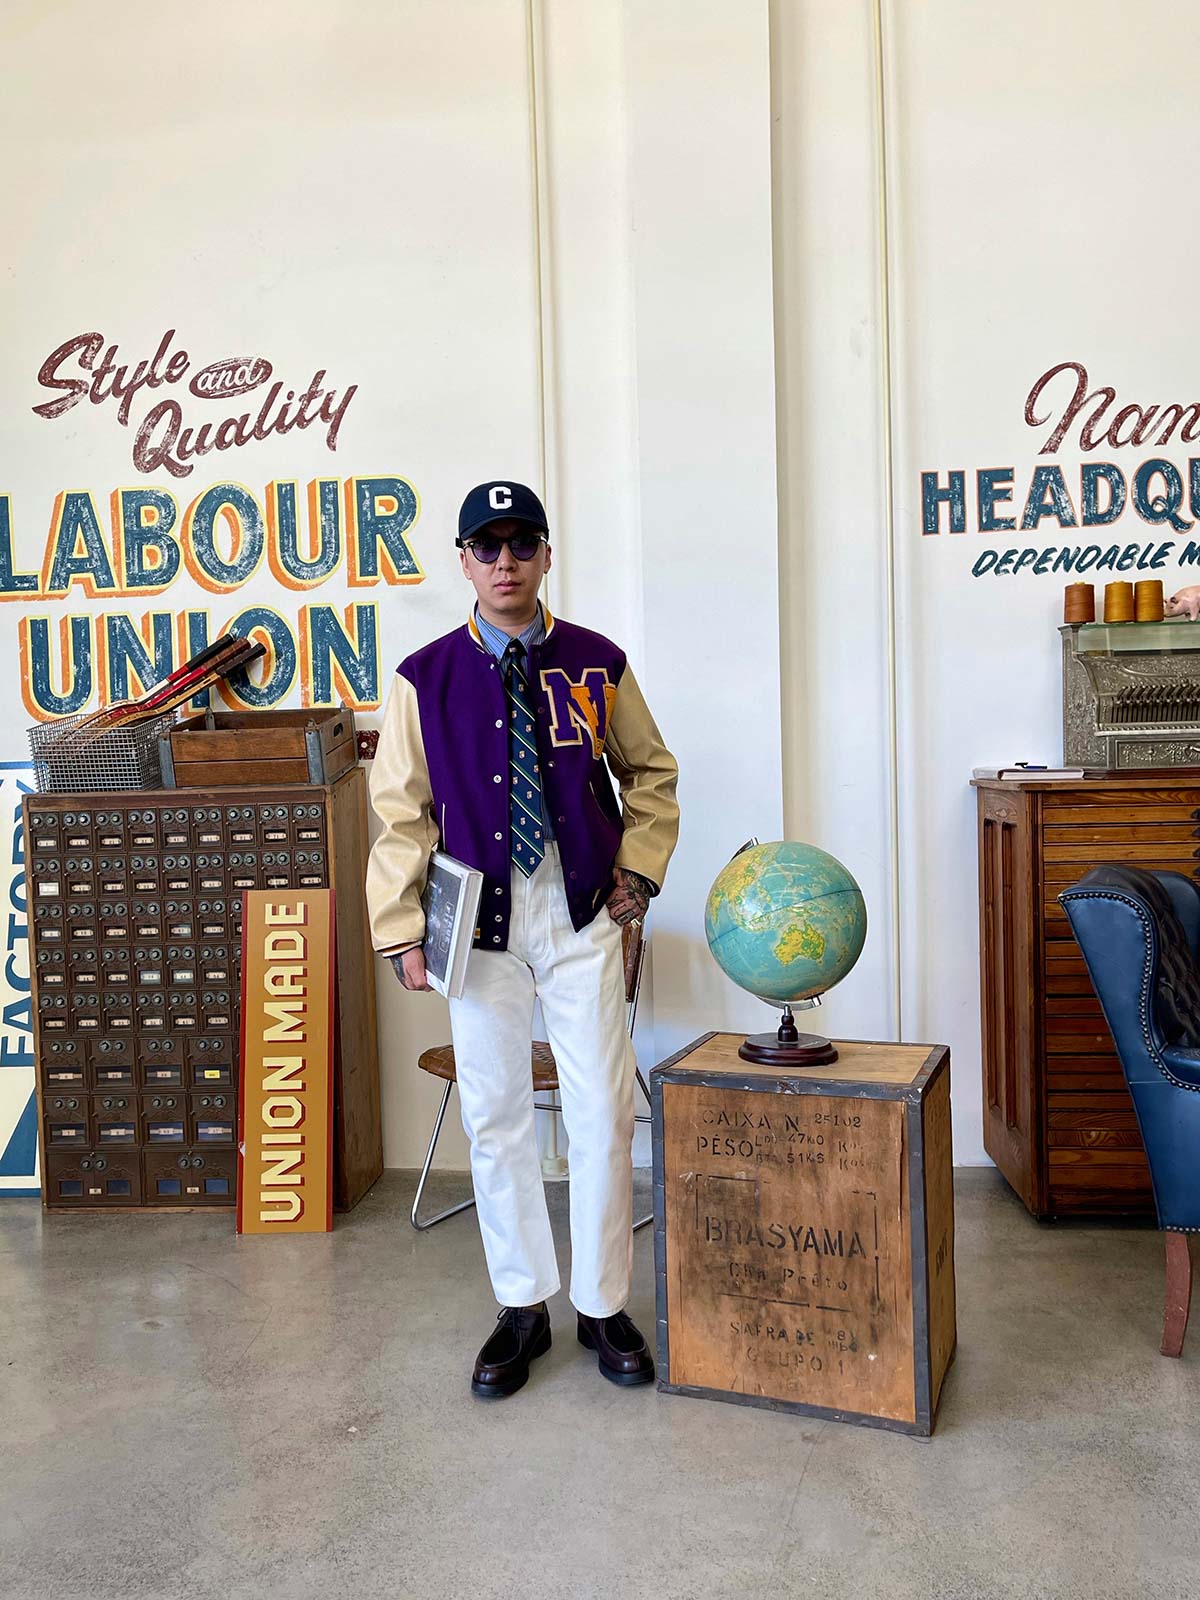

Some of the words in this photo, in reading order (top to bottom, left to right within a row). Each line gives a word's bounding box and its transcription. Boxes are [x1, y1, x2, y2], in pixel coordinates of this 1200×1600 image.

[32, 329, 191, 427] Style
[197, 358, 264, 391] and
[132, 369, 359, 478] Quality
[0, 473, 426, 601] LABOUR
[489, 486, 512, 510] C
[971, 541, 1175, 577] DEPENDABLE
[18, 601, 382, 723] UNION
[262, 901, 308, 1042] MADE
[260, 1056, 306, 1223] UNION
[702, 1109, 772, 1130] CAIXA
[705, 1216, 867, 1260] BRASYAMA
